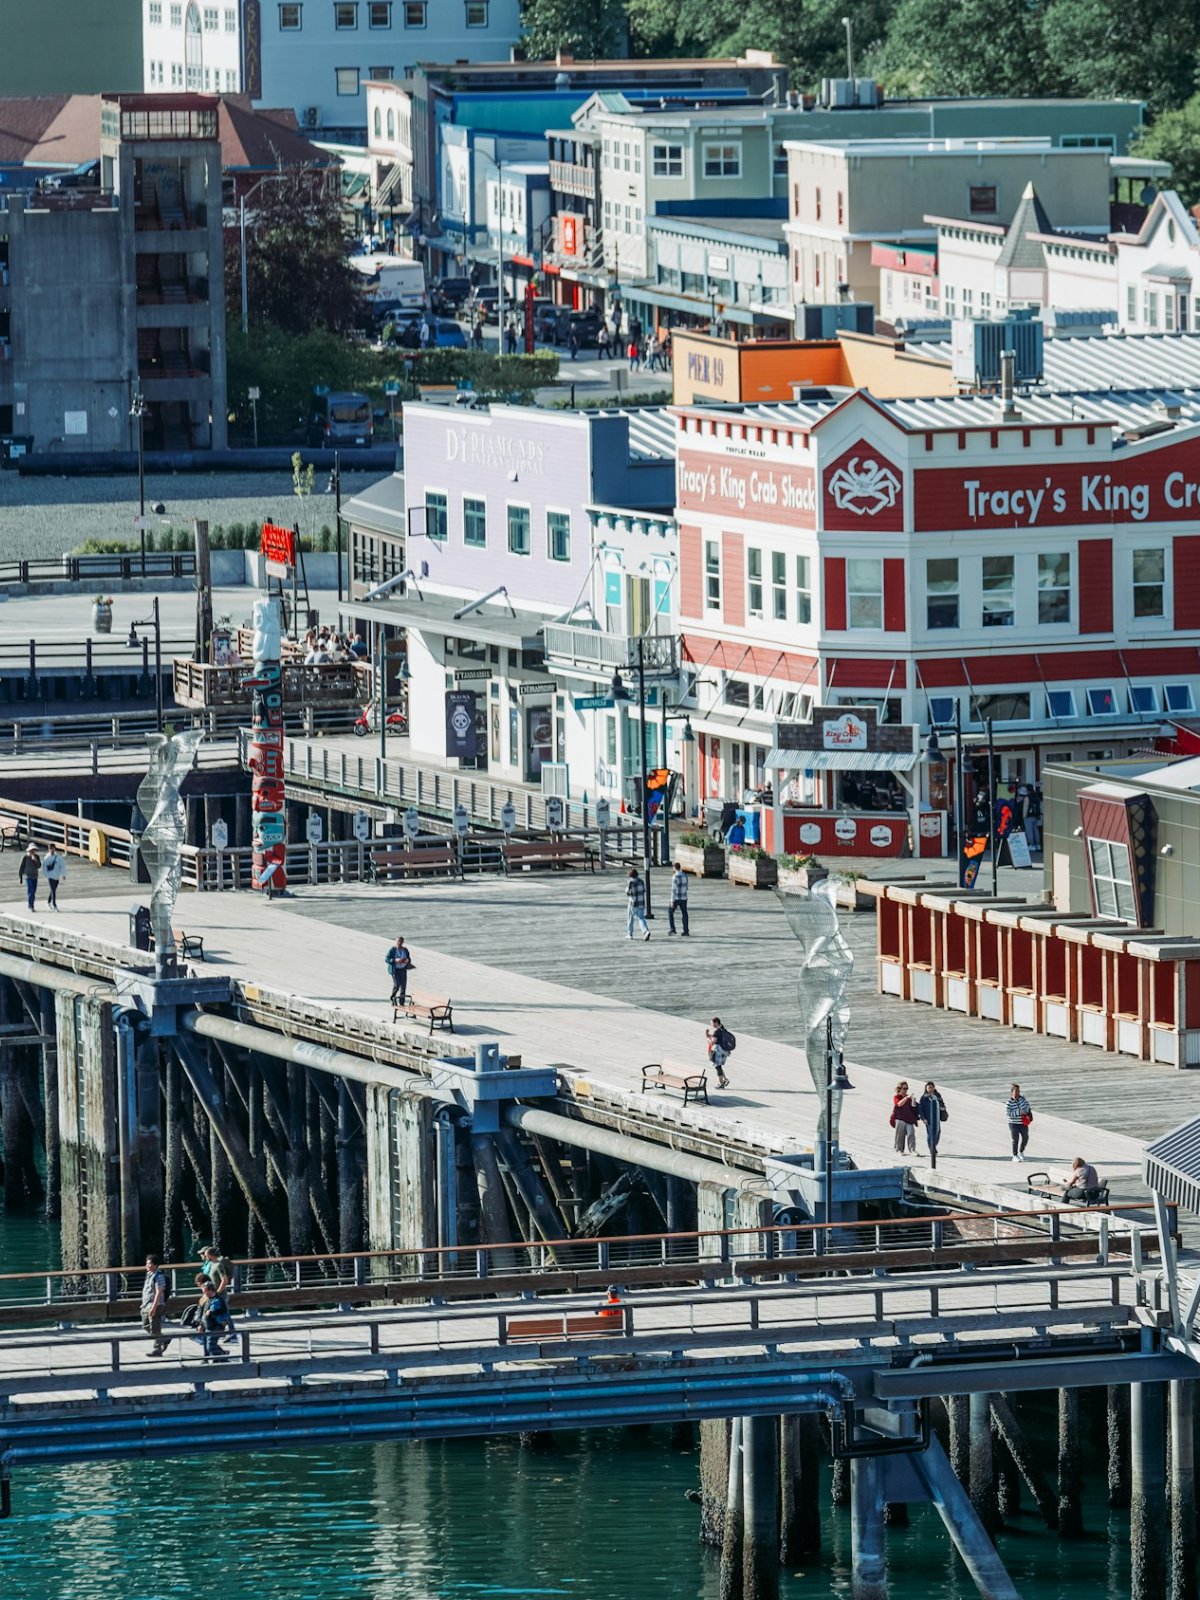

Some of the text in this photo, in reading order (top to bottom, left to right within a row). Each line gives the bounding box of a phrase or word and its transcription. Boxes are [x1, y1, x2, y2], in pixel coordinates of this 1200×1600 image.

[688, 352, 710, 383] PIER
[679, 461, 816, 511] Tracy's King Crab Shack
[964, 477, 1067, 524] Tracy's
[1081, 475, 1150, 520] King
